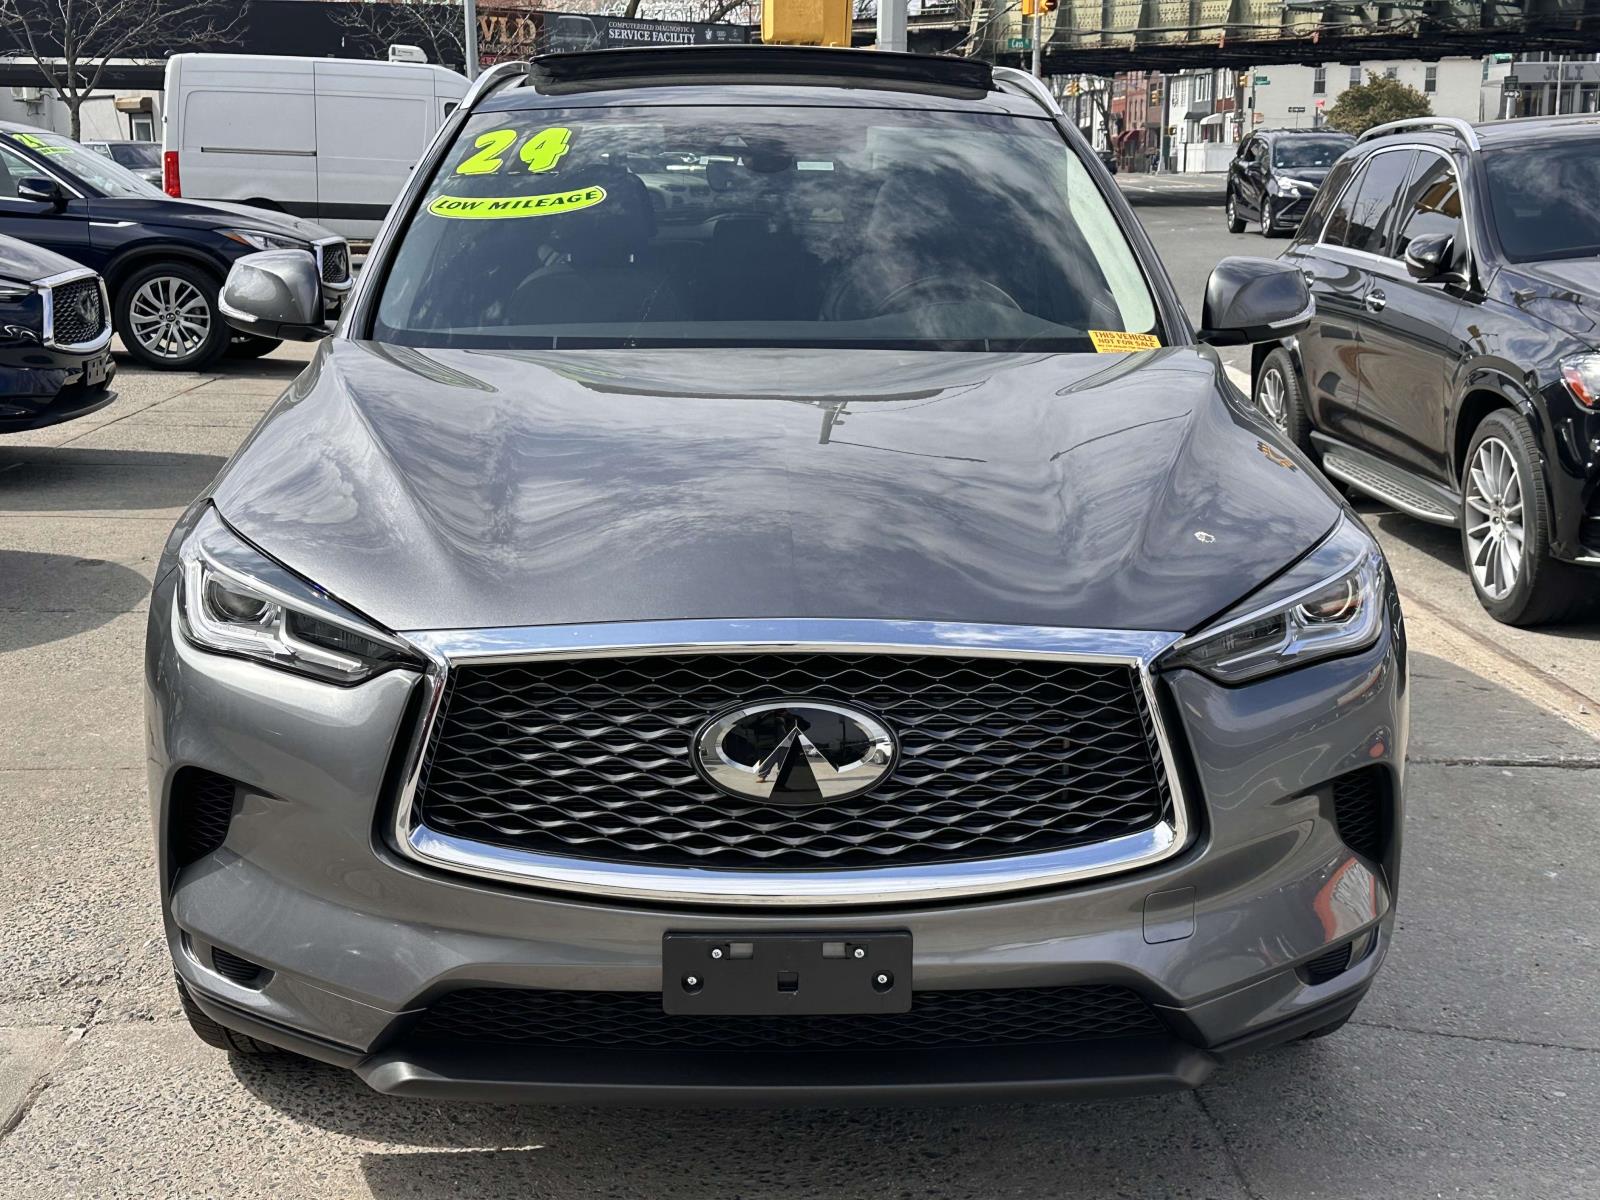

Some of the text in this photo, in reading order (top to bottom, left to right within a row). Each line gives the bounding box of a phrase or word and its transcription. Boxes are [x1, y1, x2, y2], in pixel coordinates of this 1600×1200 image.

[608, 29, 696, 43] SERVICE FACILITY
[456, 127, 572, 175] 24
[436, 190, 599, 210] LOW MILEAGE
[1093, 331, 1156, 342] THIS VEHICLE
